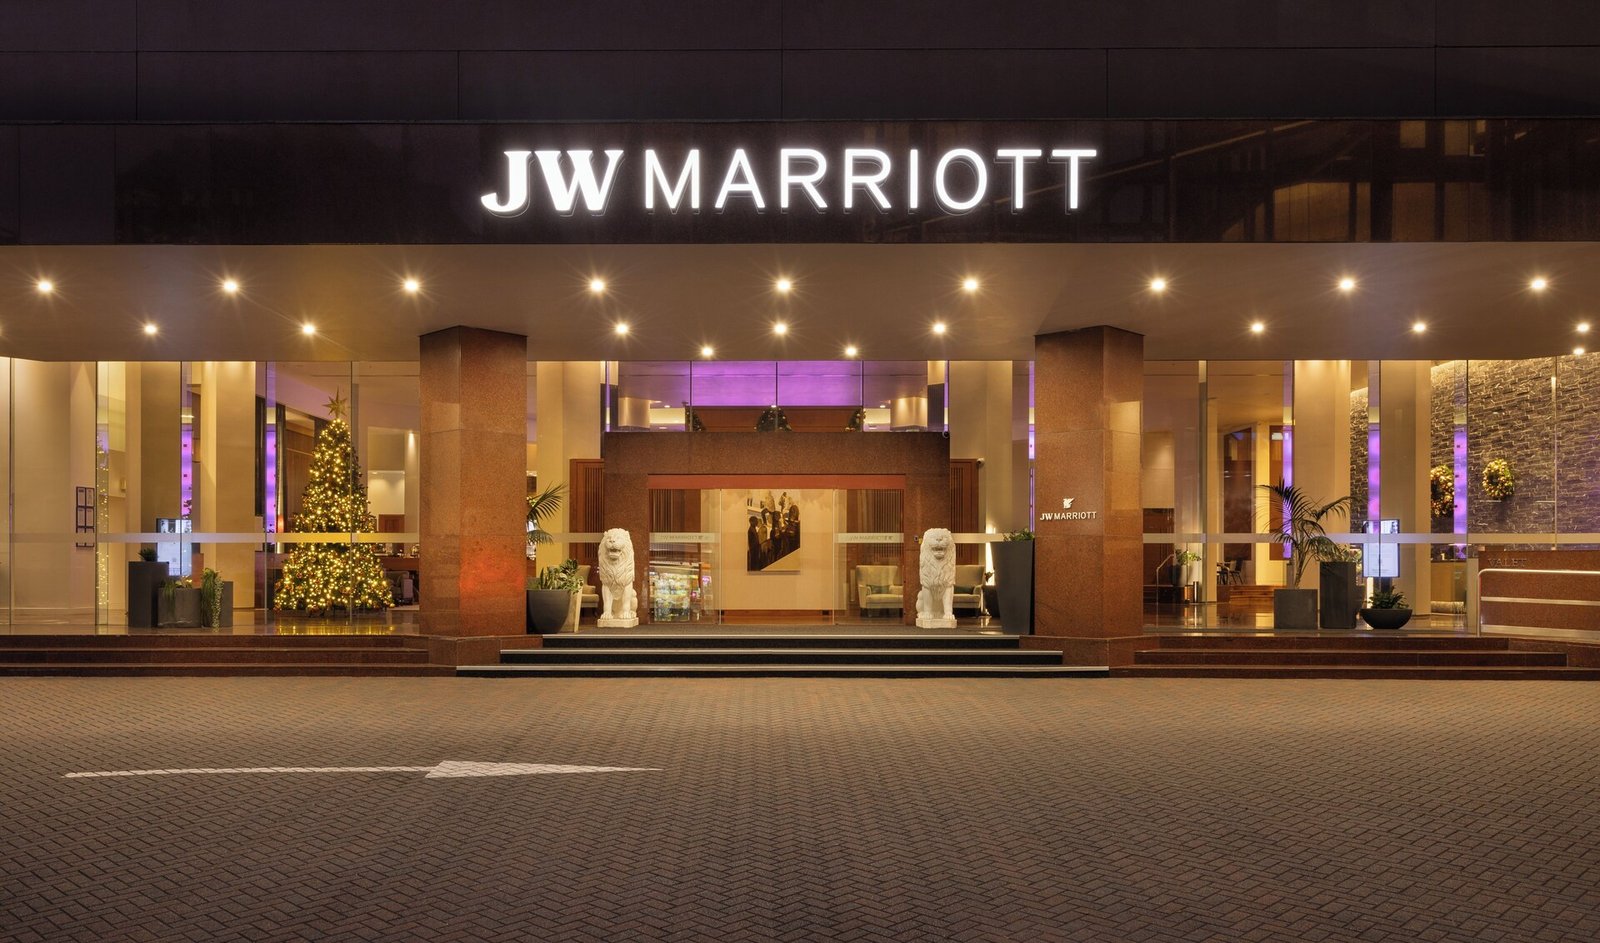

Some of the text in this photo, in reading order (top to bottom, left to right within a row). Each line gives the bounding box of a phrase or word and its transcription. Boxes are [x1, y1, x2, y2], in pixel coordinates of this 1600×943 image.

[481, 148, 1097, 213] JW MARRIOTT
[1040, 511, 1097, 521] JW MARRIOTT
[1488, 558, 1527, 567] VALET
